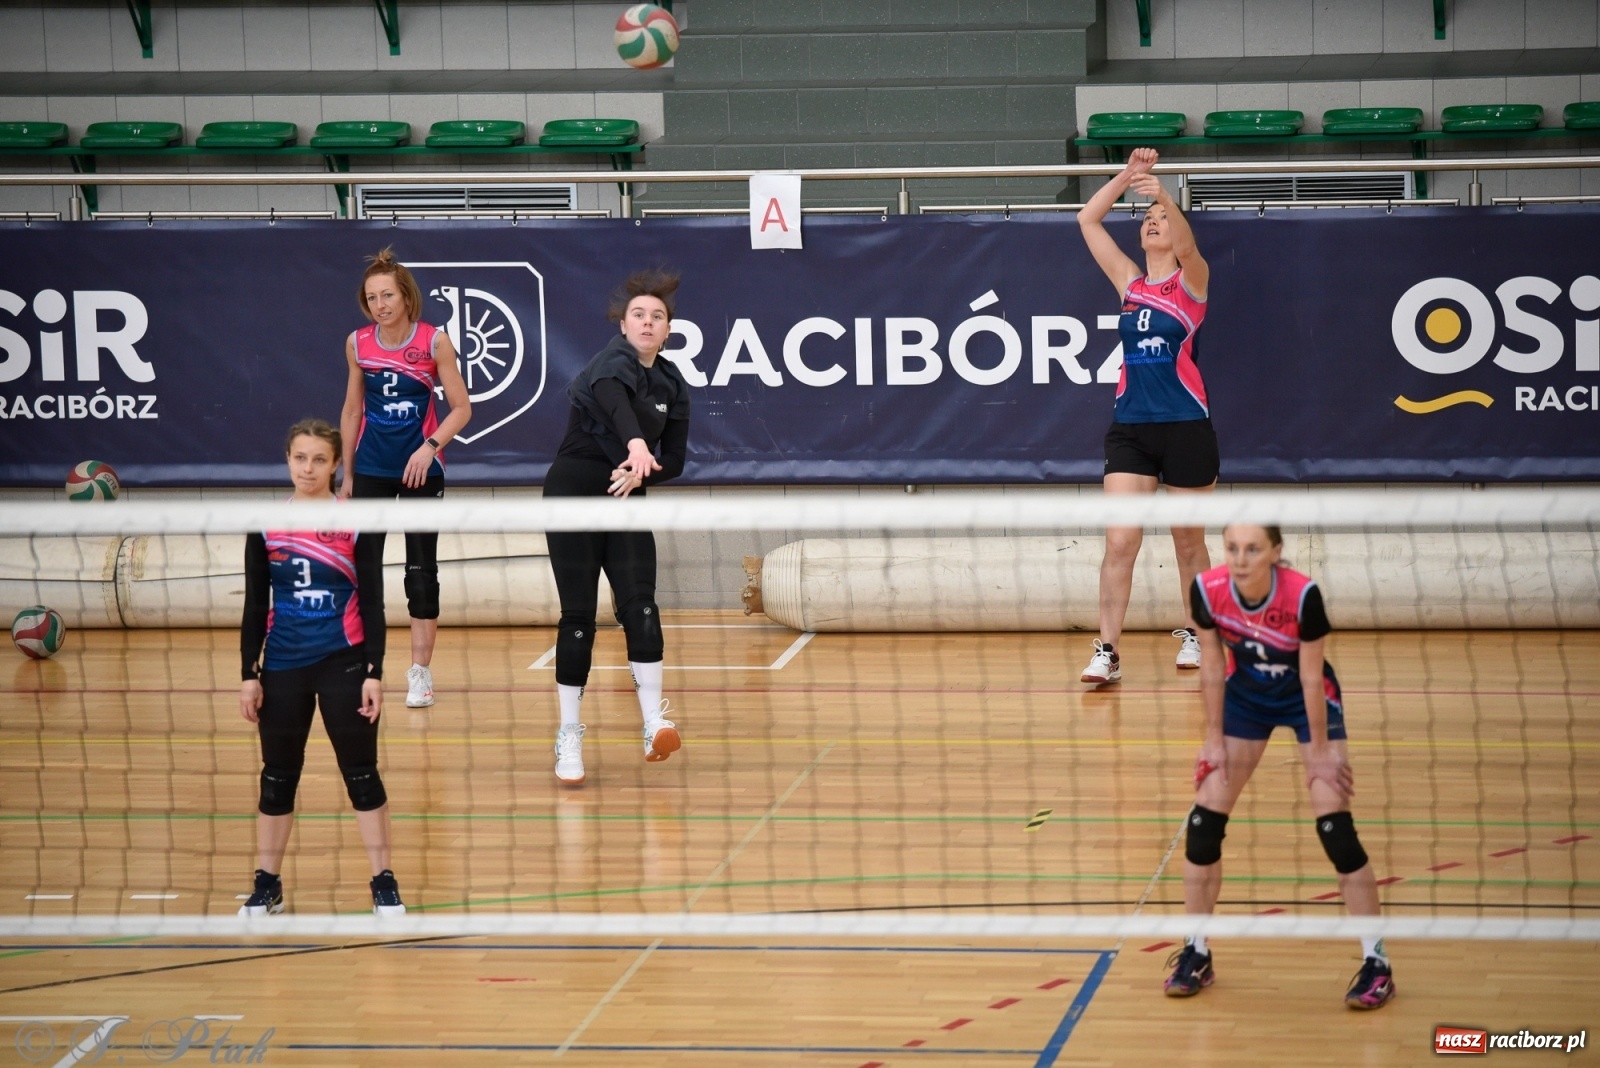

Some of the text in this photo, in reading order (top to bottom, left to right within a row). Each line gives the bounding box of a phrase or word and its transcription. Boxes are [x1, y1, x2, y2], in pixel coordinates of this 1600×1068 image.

[760, 197, 788, 232] A
[1136, 308, 1152, 332] 8
[657, 289, 1125, 388] RACIBÓRZ
[382, 371, 398, 398] 2
[1515, 386, 1599, 411] RACI
[0, 387, 159, 419] RACIBÓRZ
[291, 557, 312, 588] 3
